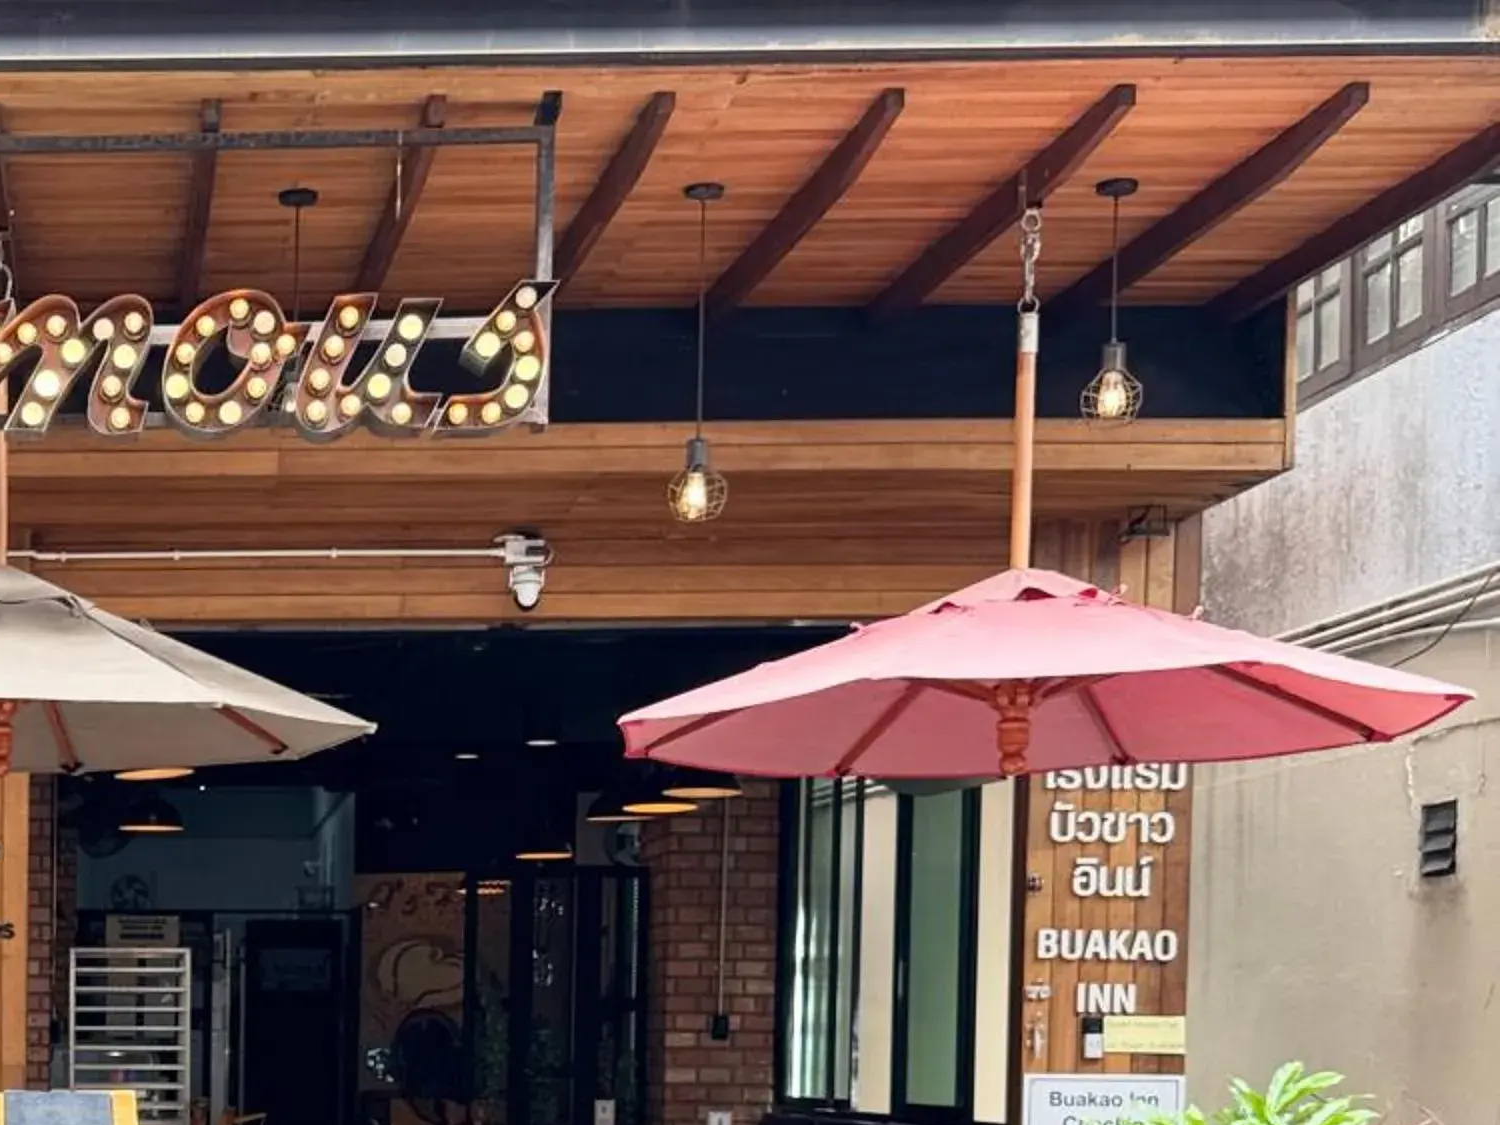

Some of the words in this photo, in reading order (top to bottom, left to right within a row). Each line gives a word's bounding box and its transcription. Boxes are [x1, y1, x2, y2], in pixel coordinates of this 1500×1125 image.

[1049, 801, 1176, 844] บัวขาว
[1072, 855, 1155, 898] อินน์
[1037, 929, 1178, 962] BUAKAO
[1076, 983, 1136, 1013] INN
[1049, 1091, 1123, 1107] Buakao
